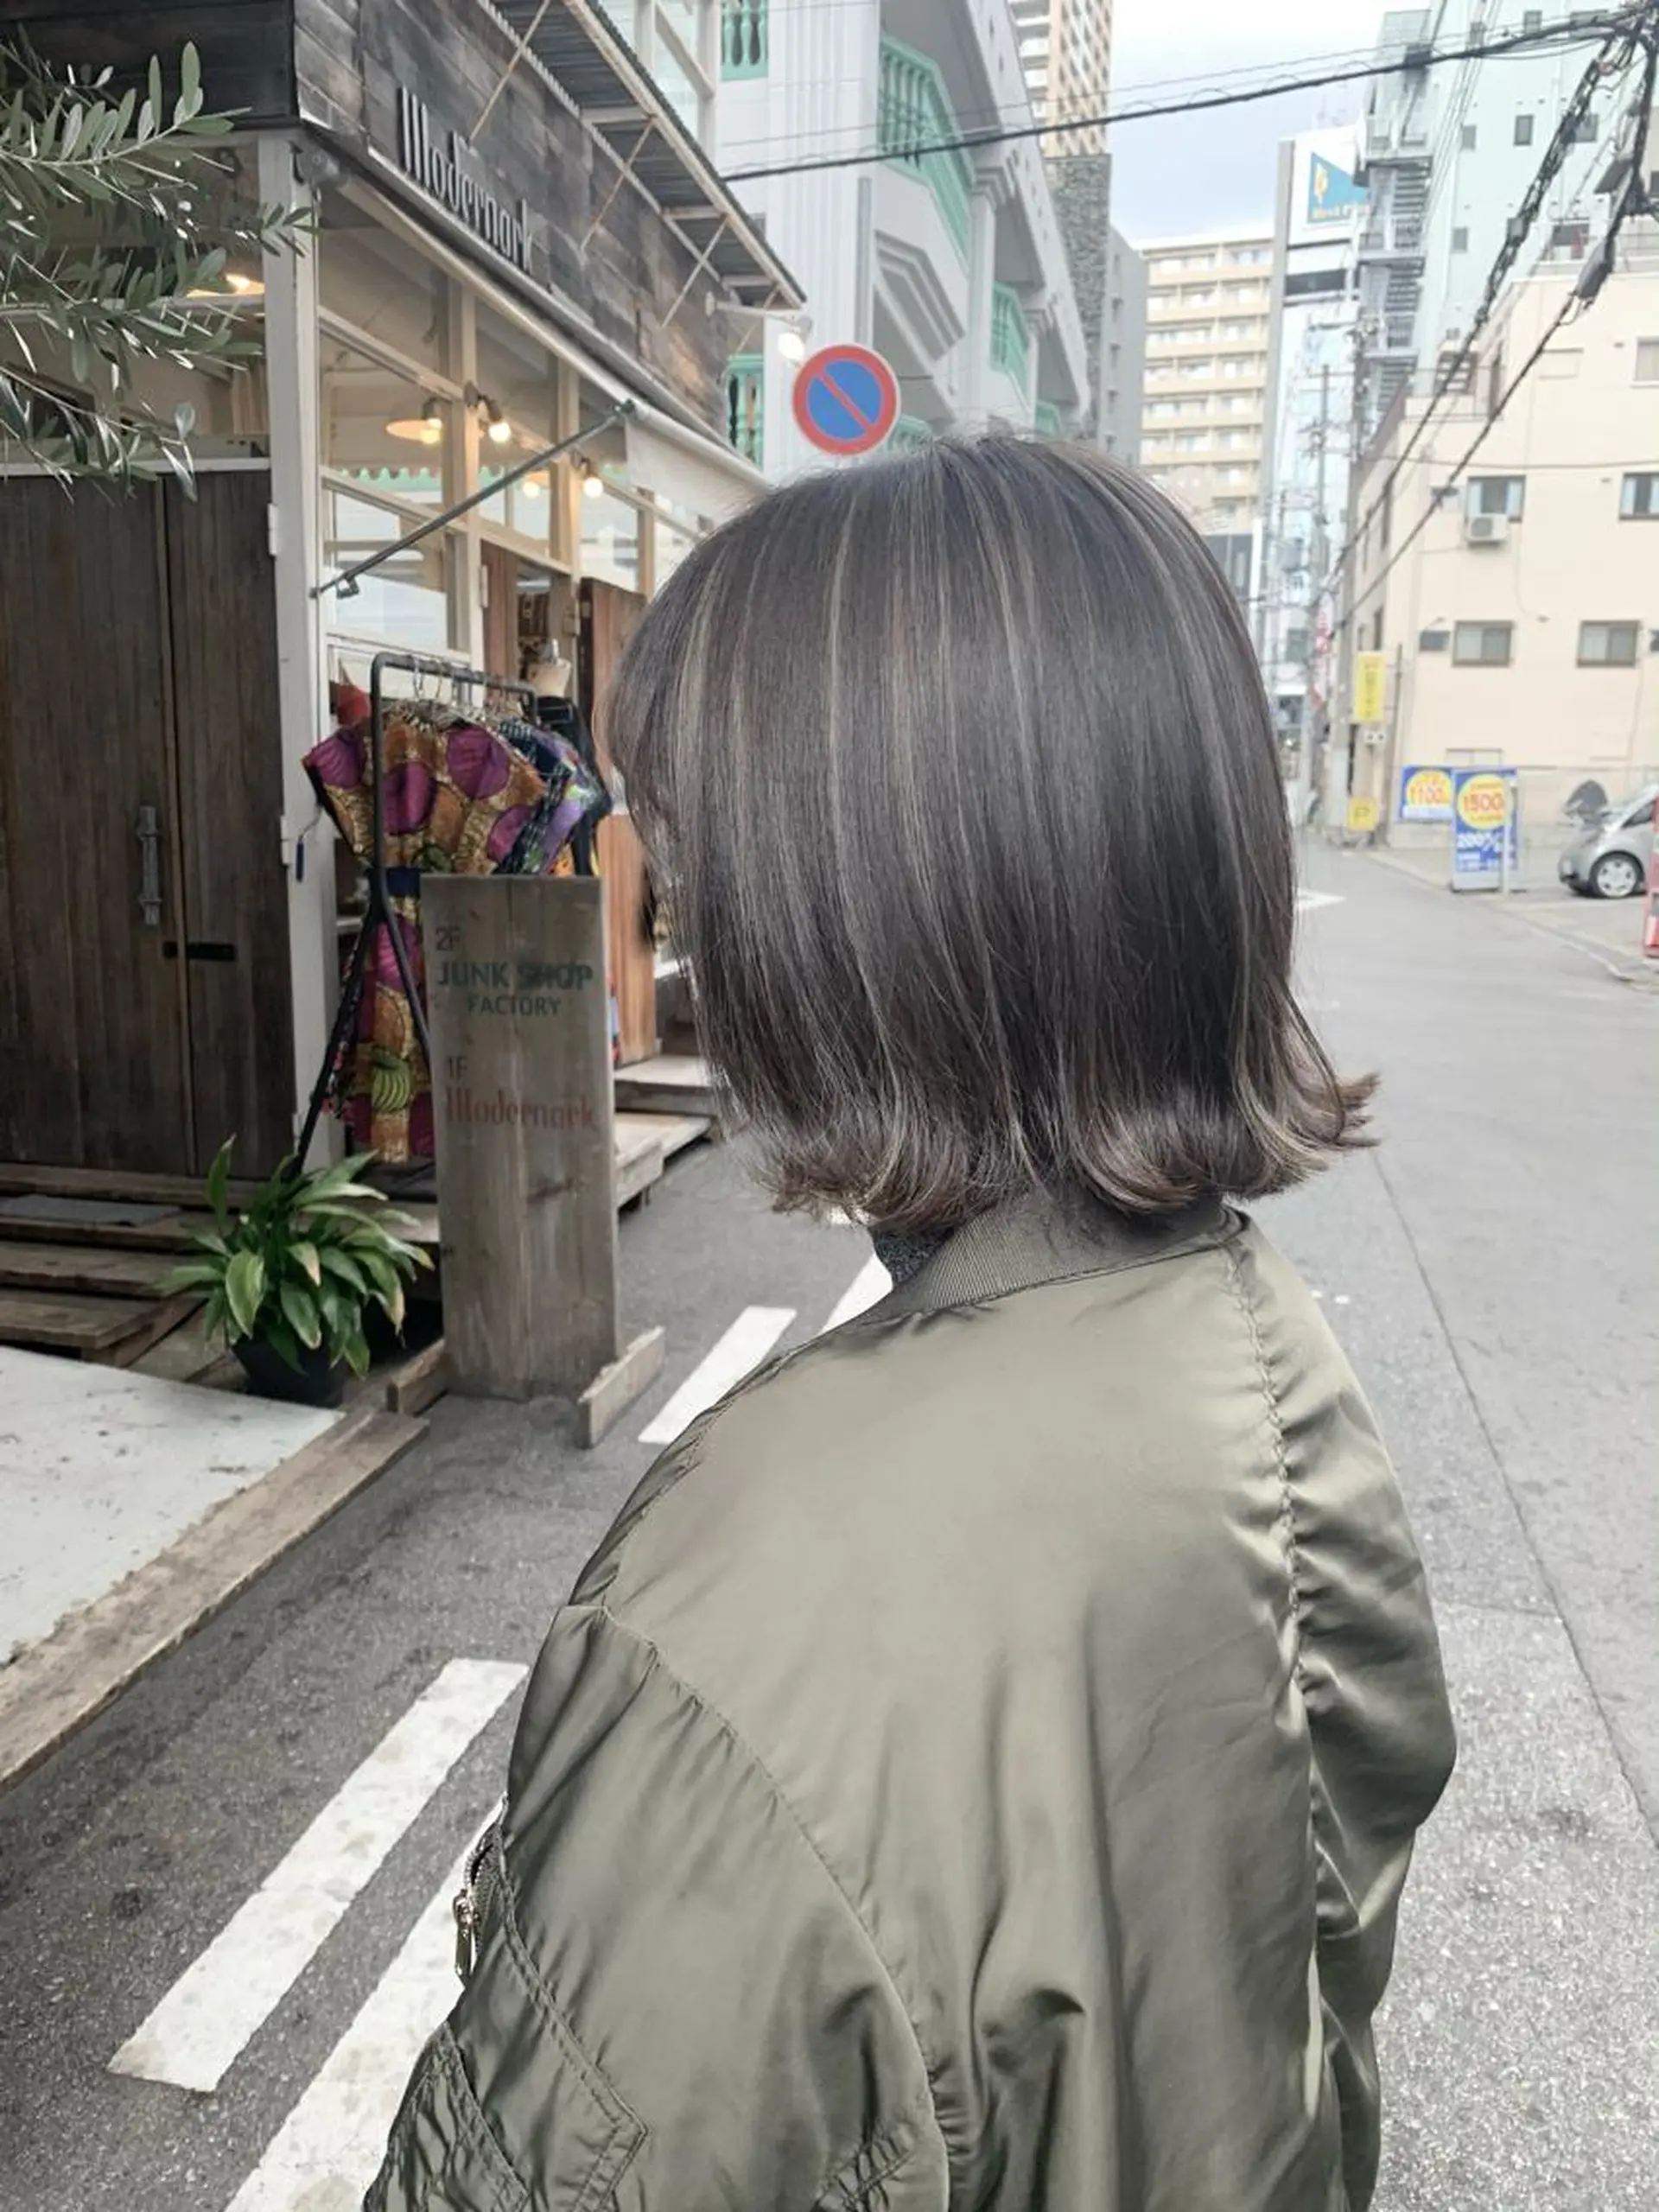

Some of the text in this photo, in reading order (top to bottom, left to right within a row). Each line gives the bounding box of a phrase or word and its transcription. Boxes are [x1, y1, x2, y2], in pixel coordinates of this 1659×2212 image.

[435, 926, 461, 951] 2F
[437, 961, 594, 990] JUNK SHOP
[467, 995, 562, 1018] FACTORY
[447, 1056, 468, 1080] 1F
